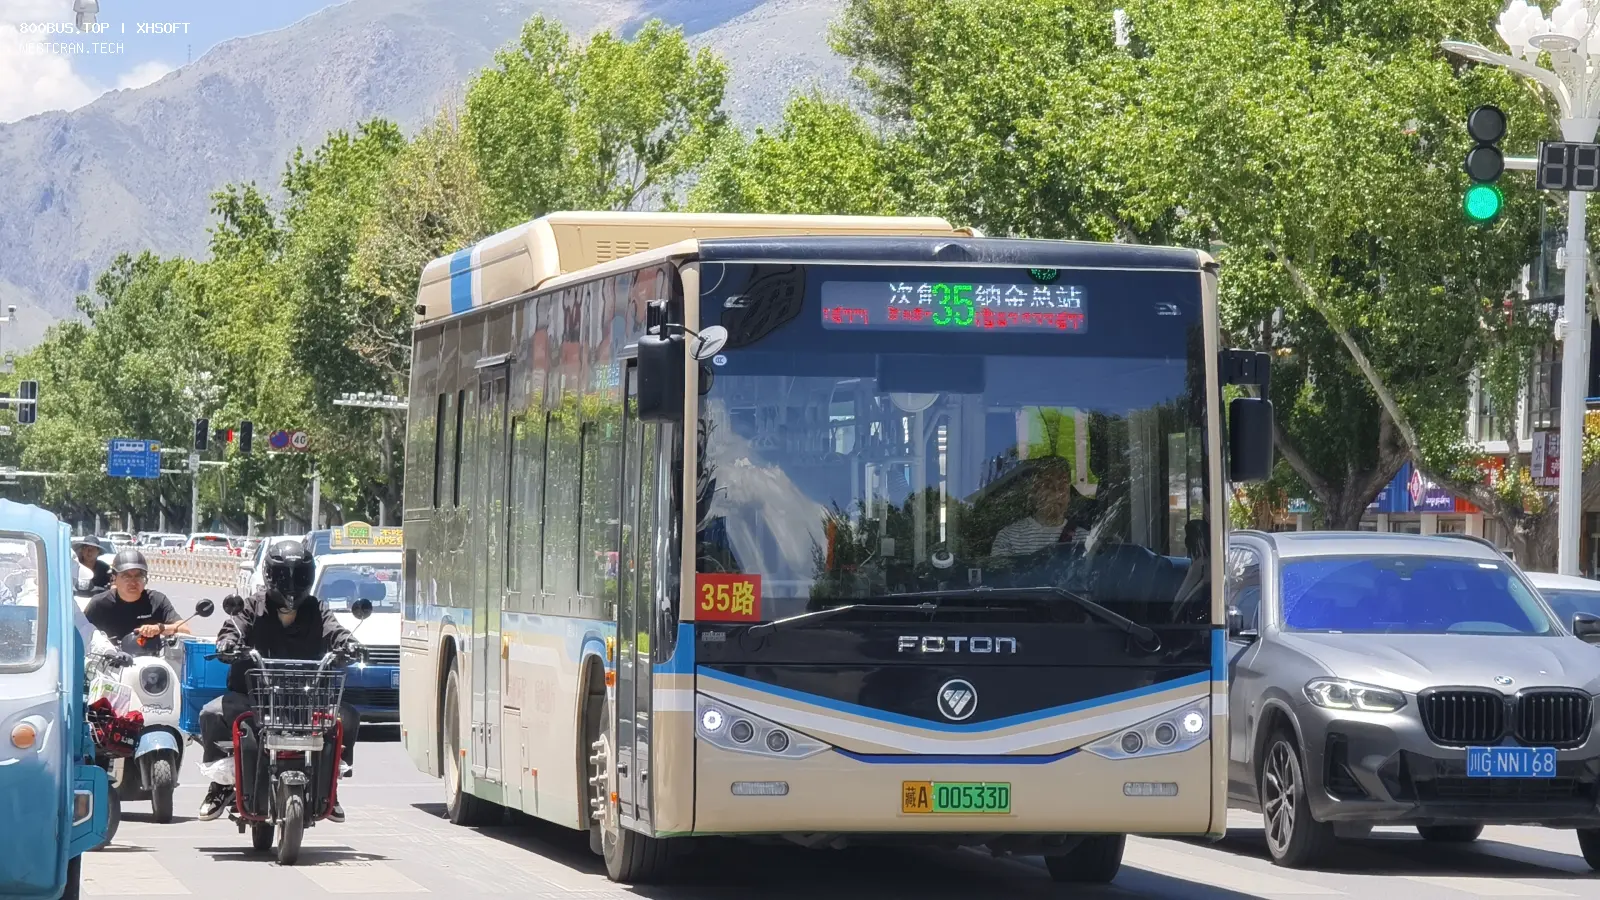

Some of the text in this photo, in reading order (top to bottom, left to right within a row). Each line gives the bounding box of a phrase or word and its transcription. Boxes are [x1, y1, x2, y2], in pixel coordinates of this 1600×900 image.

[932, 282, 975, 326] 35
[294, 435, 306, 445] 40
[701, 581, 755, 615] 35路
[897, 636, 1017, 653] FOTON
